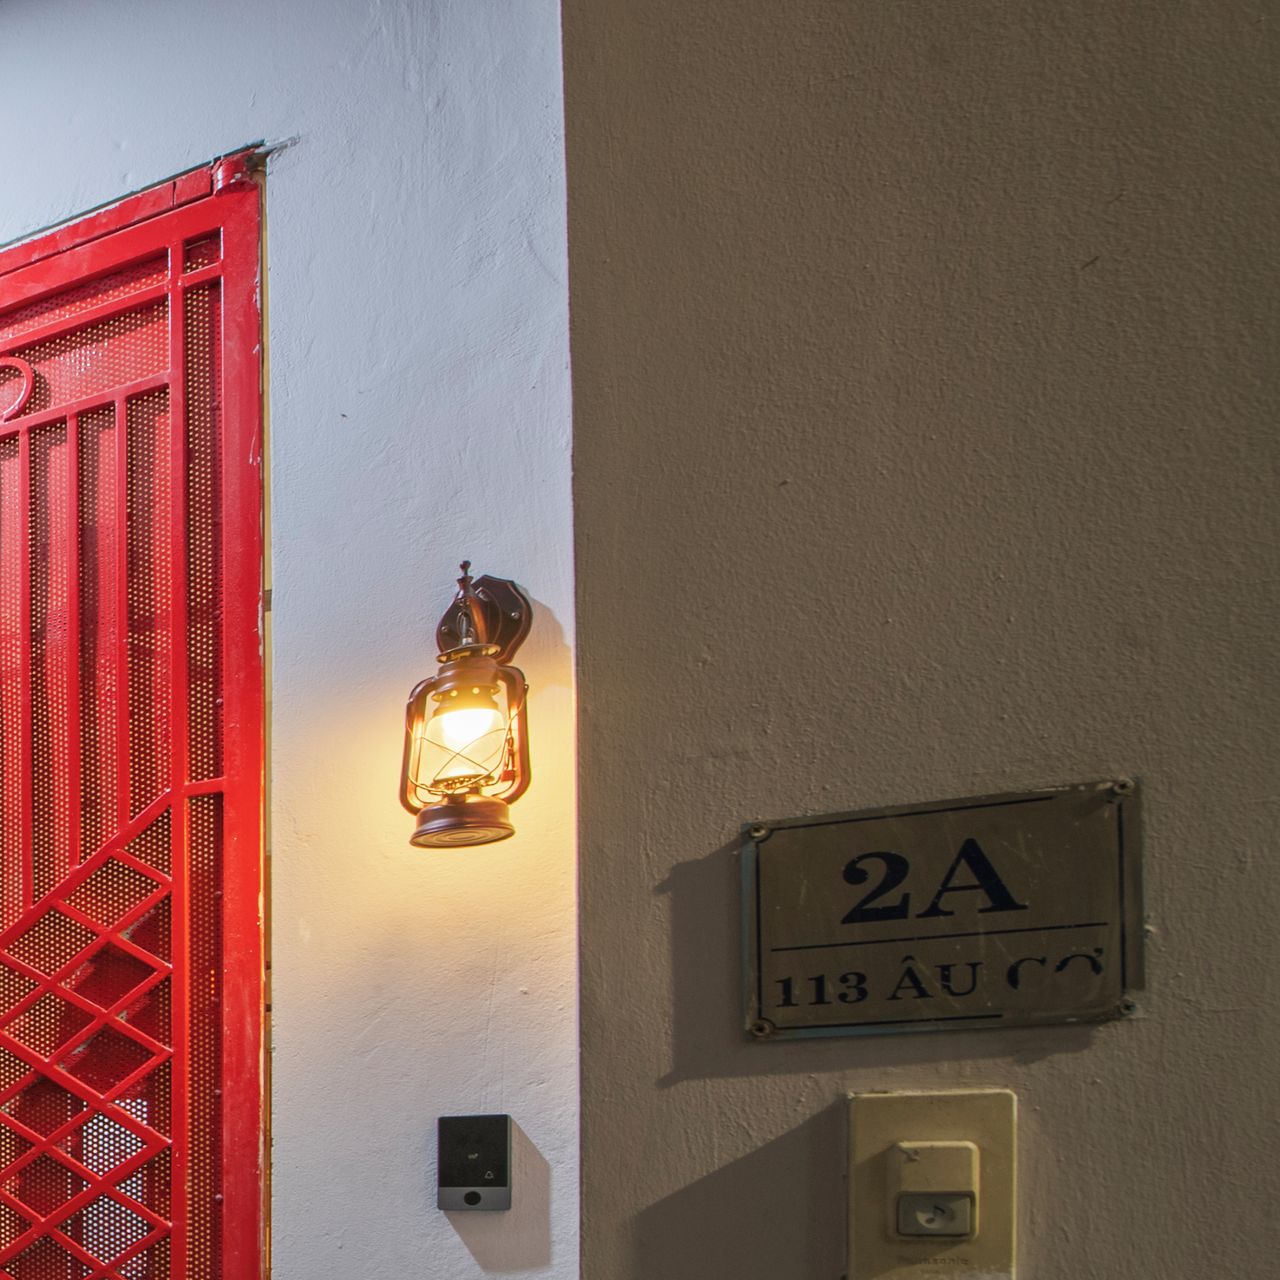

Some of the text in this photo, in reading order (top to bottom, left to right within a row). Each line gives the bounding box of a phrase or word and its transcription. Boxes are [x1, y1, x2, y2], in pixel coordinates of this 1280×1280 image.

[840, 838, 1029, 925] 2A
[775, 971, 869, 1009] 113
[886, 954, 984, 1002] ÂU
